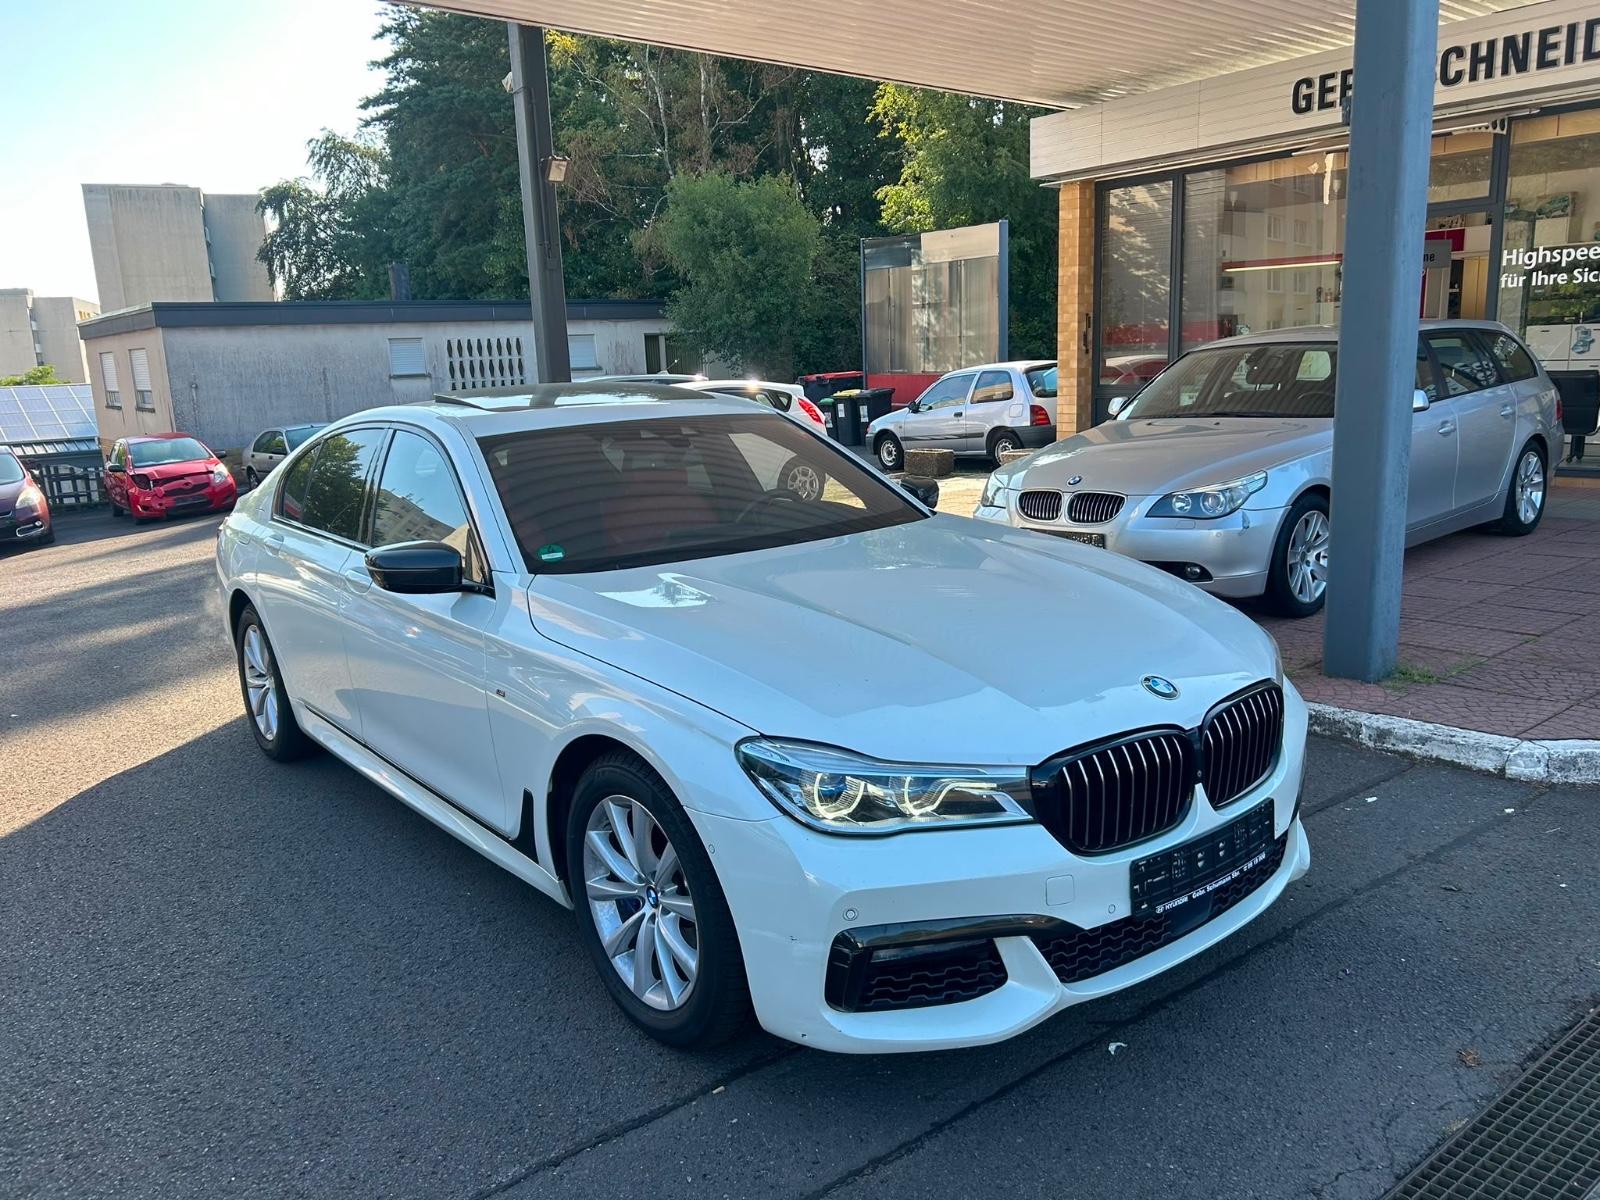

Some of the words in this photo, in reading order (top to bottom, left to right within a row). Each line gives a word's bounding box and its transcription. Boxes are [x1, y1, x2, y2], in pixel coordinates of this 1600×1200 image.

[1435, 17, 1600, 86] CHNEID
[1502, 246, 1600, 269] Highspee
[1500, 273, 1527, 288] für
[1531, 270, 1568, 286] Ihre
[1572, 268, 1600, 284] Sic
